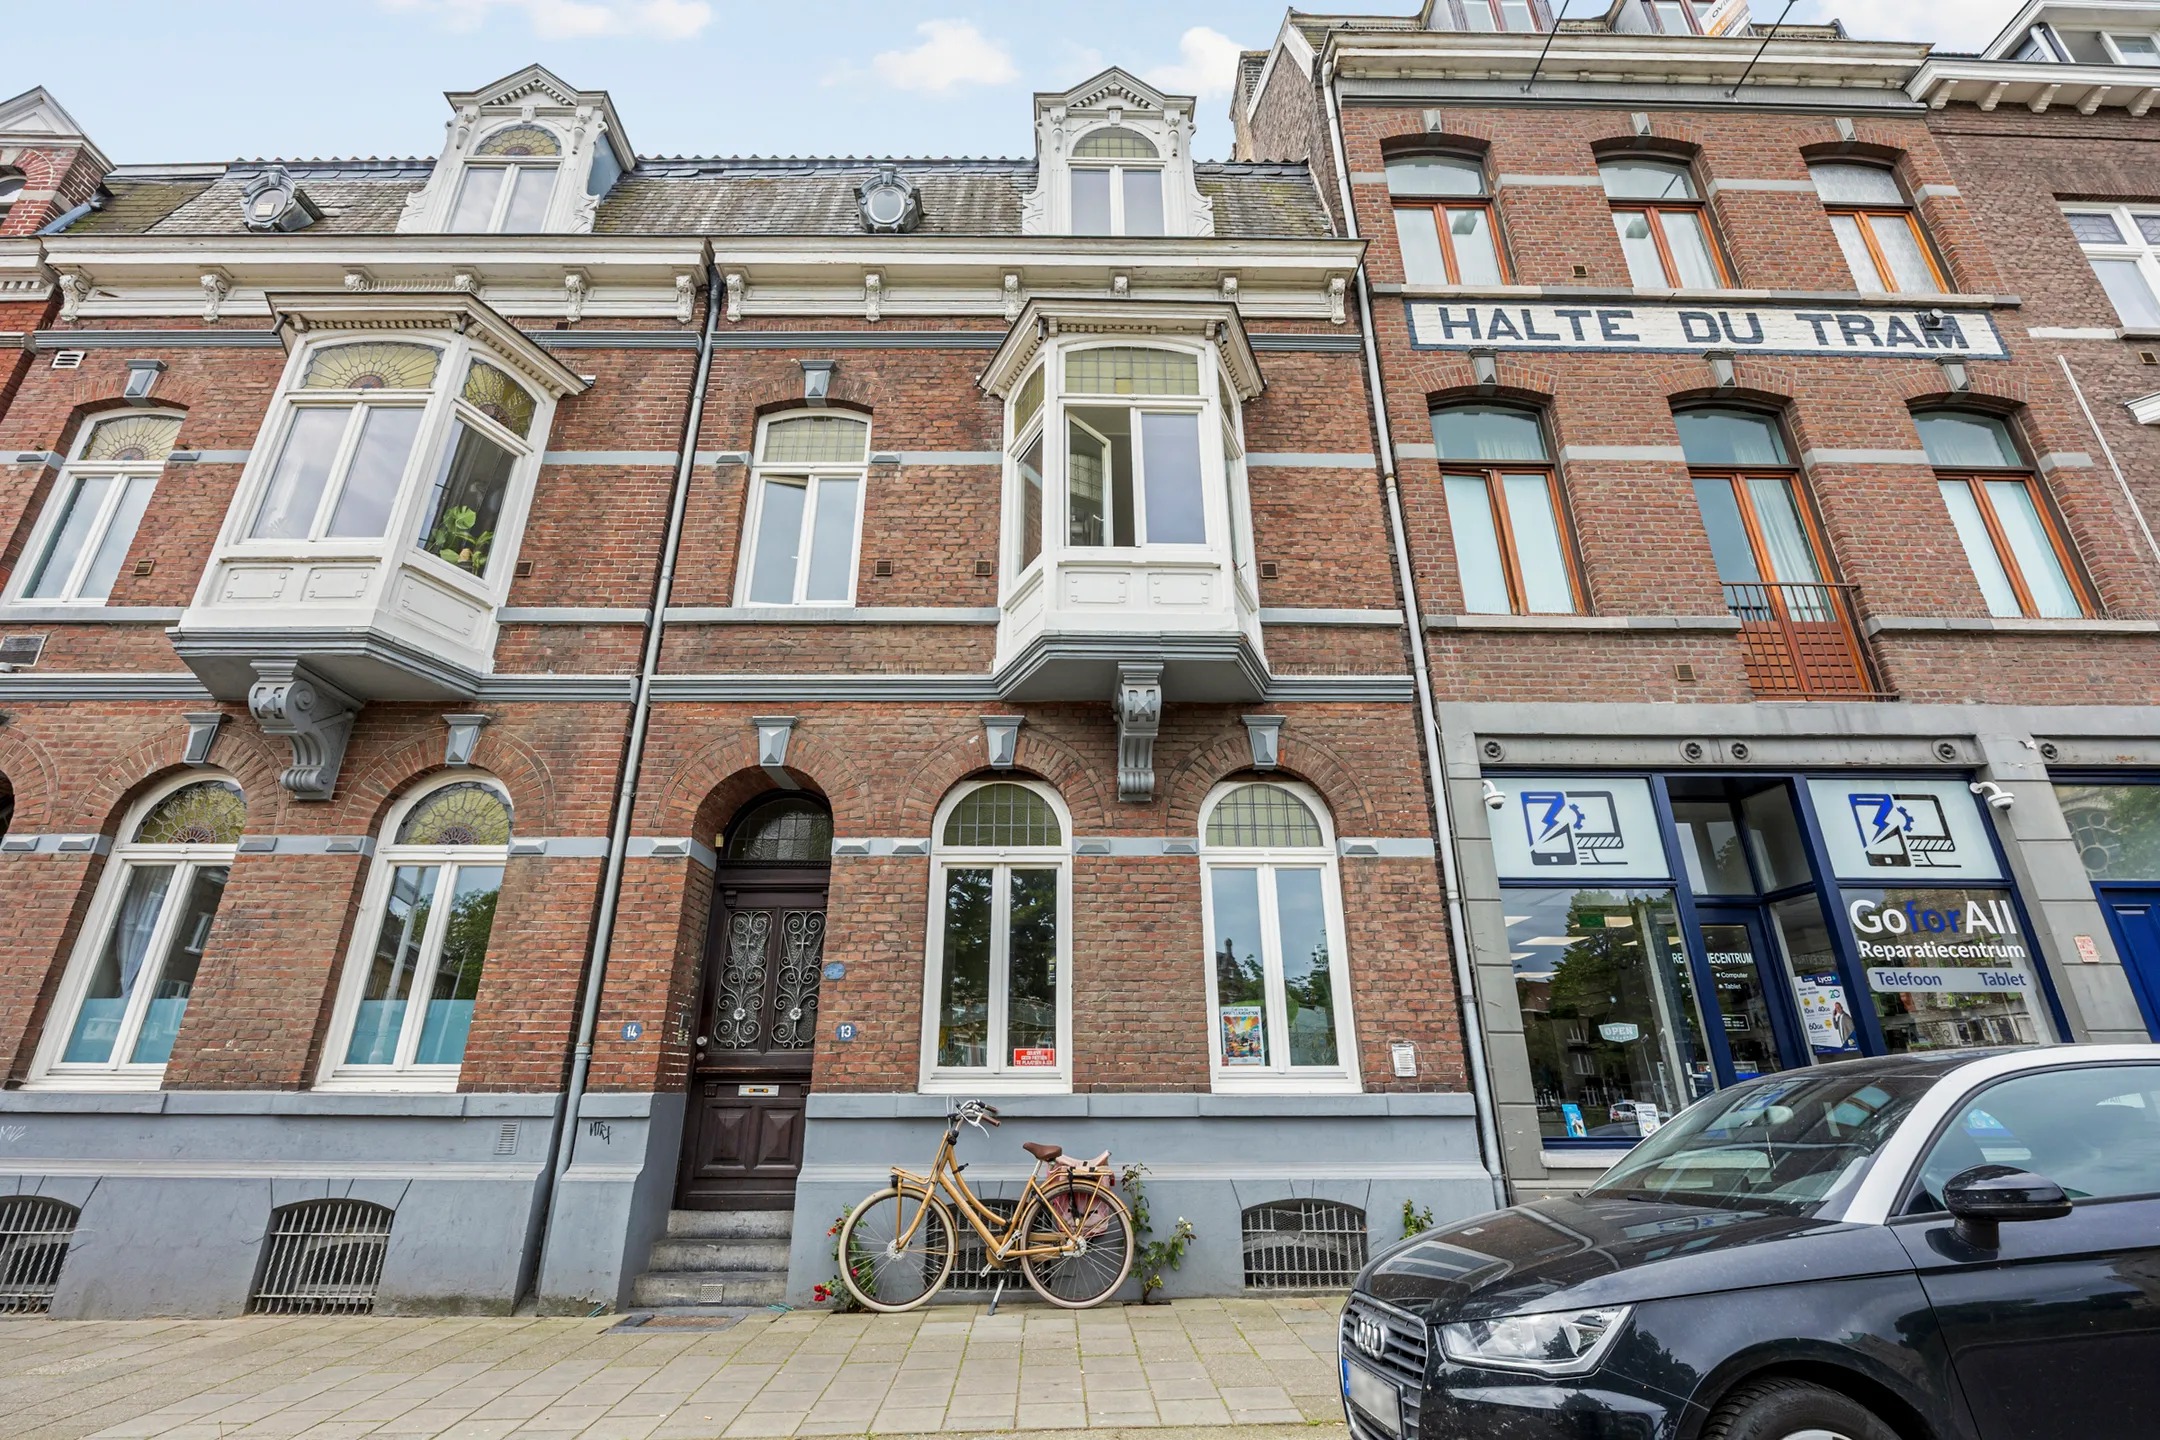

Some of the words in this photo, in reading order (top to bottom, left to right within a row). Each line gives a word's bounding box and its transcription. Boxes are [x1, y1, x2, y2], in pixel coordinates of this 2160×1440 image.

[1438, 306, 1640, 342] HALTE
[1678, 311, 1765, 344] DU
[1794, 312, 1970, 349] TRAM
[1859, 940, 2026, 961] Reparatiecentrum
[1720, 971, 1748, 979] Computer
[1875, 971, 1943, 986] Telefoon
[1978, 971, 2027, 986] Tablet
[626, 1024, 638, 1038] 14
[840, 1024, 852, 1038] 13
[1605, 1026, 1633, 1035] OPEN
